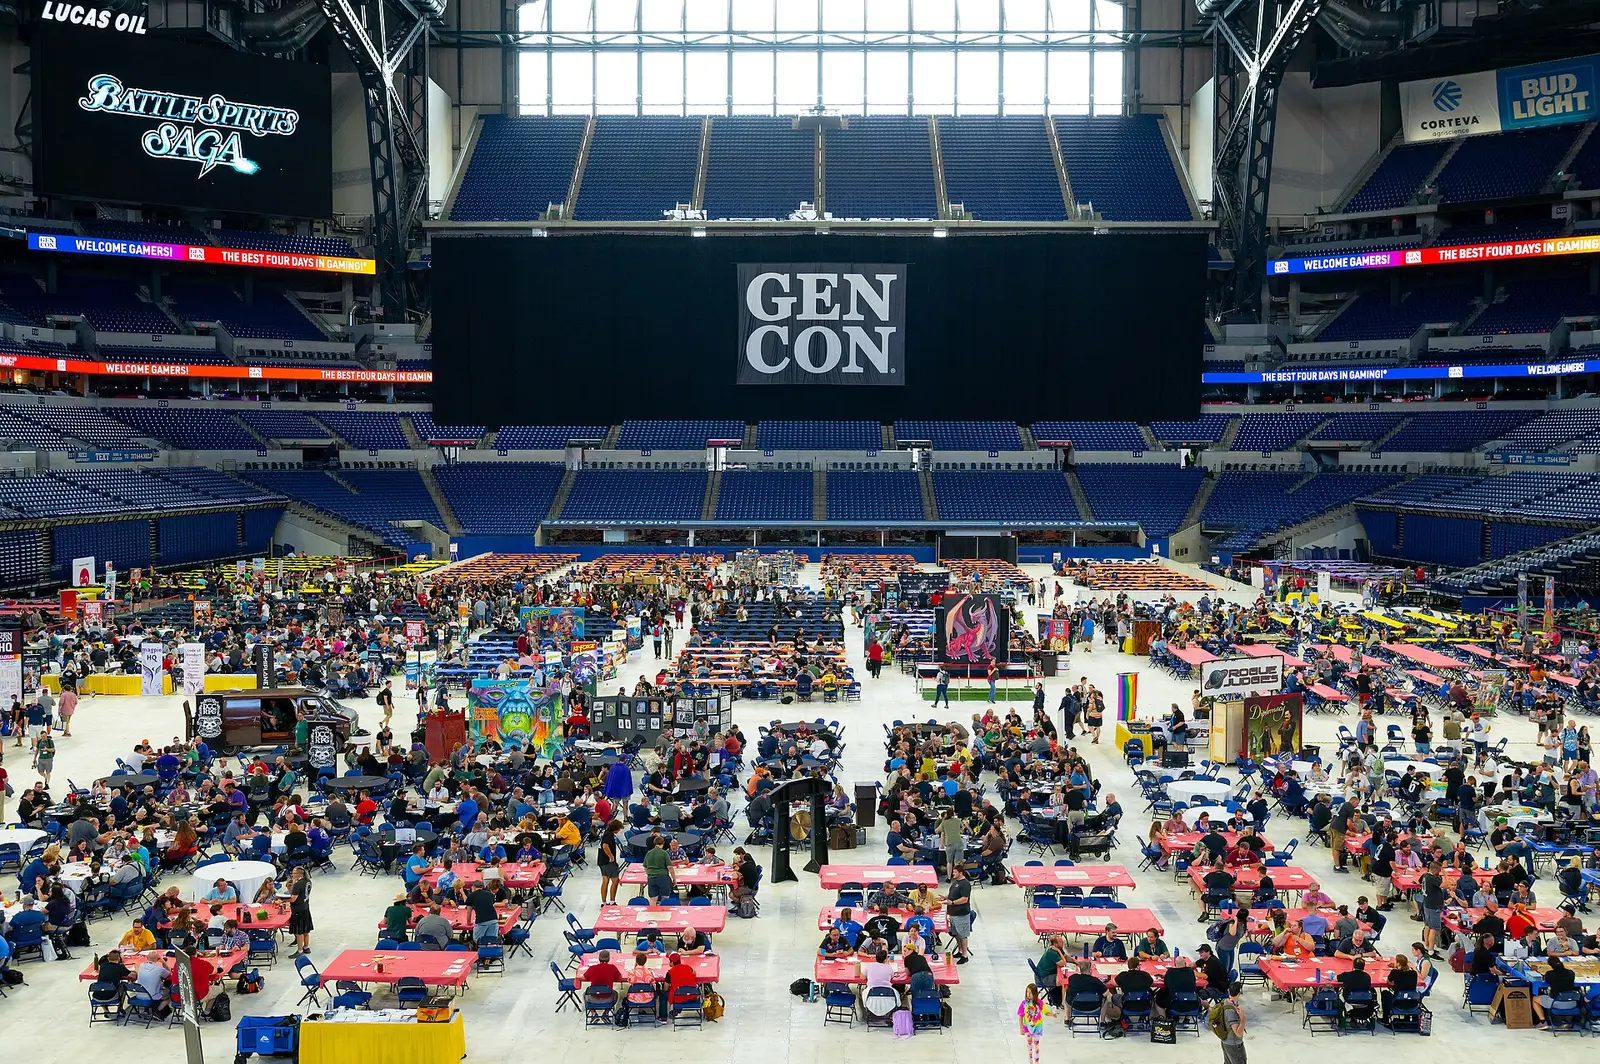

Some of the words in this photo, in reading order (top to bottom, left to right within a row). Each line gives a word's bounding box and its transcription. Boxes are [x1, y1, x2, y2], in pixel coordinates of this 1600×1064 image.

[41, 0, 111, 29] LUCAS
[115, 13, 147, 35] OIL
[1521, 73, 1577, 99] BUD
[78, 74, 200, 121] BATTLE
[197, 94, 299, 137] SPIRITS
[1512, 91, 1590, 120] LIGHT
[1420, 115, 1480, 130] CORTEVA
[1432, 127, 1470, 137] agriscience
[142, 122, 246, 177] SAGA
[75, 239, 127, 254] WELCOME
[128, 243, 173, 257] GAMERS!
[1438, 249, 1457, 260] THE
[1459, 247, 1484, 259] BEST
[1486, 245, 1513, 257] FOUR
[1514, 243, 1541, 255] DAYS
[1543, 242, 1554, 252] IN
[221, 251, 240, 262] THE
[241, 252, 264, 263] BEST
[266, 254, 290, 266] FOUR
[292, 257, 314, 268] DAYS
[316, 259, 324, 268] IN
[1303, 257, 1349, 270] WELCOME
[1349, 254, 1390, 267] GAMERS!
[746, 272, 898, 322] GEN
[105, 363, 150, 374] WELCOME
[151, 364, 189, 375] GAMERS!
[320, 370, 335, 379] THE
[337, 371, 355, 379] BEST
[356, 371, 375, 380] FOUR
[377, 372, 395, 381] DAYS
[397, 373, 404, 381] IN
[1262, 373, 1276, 382] THE
[1277, 372, 1296, 381] BEST
[1297, 372, 1317, 381] FOUR
[1318, 371, 1338, 380] DAYS
[1339, 371, 1348, 379] IN
[1527, 363, 1561, 375] WELCOME
[1561, 362, 1585, 373] GAMERS!
[261, 646, 270, 687] DEMIPLANE
[1228, 665, 1277, 678] ROGUE
[1223, 674, 1279, 687] JUDGES
[1249, 700, 1287, 724] Diplomacy
